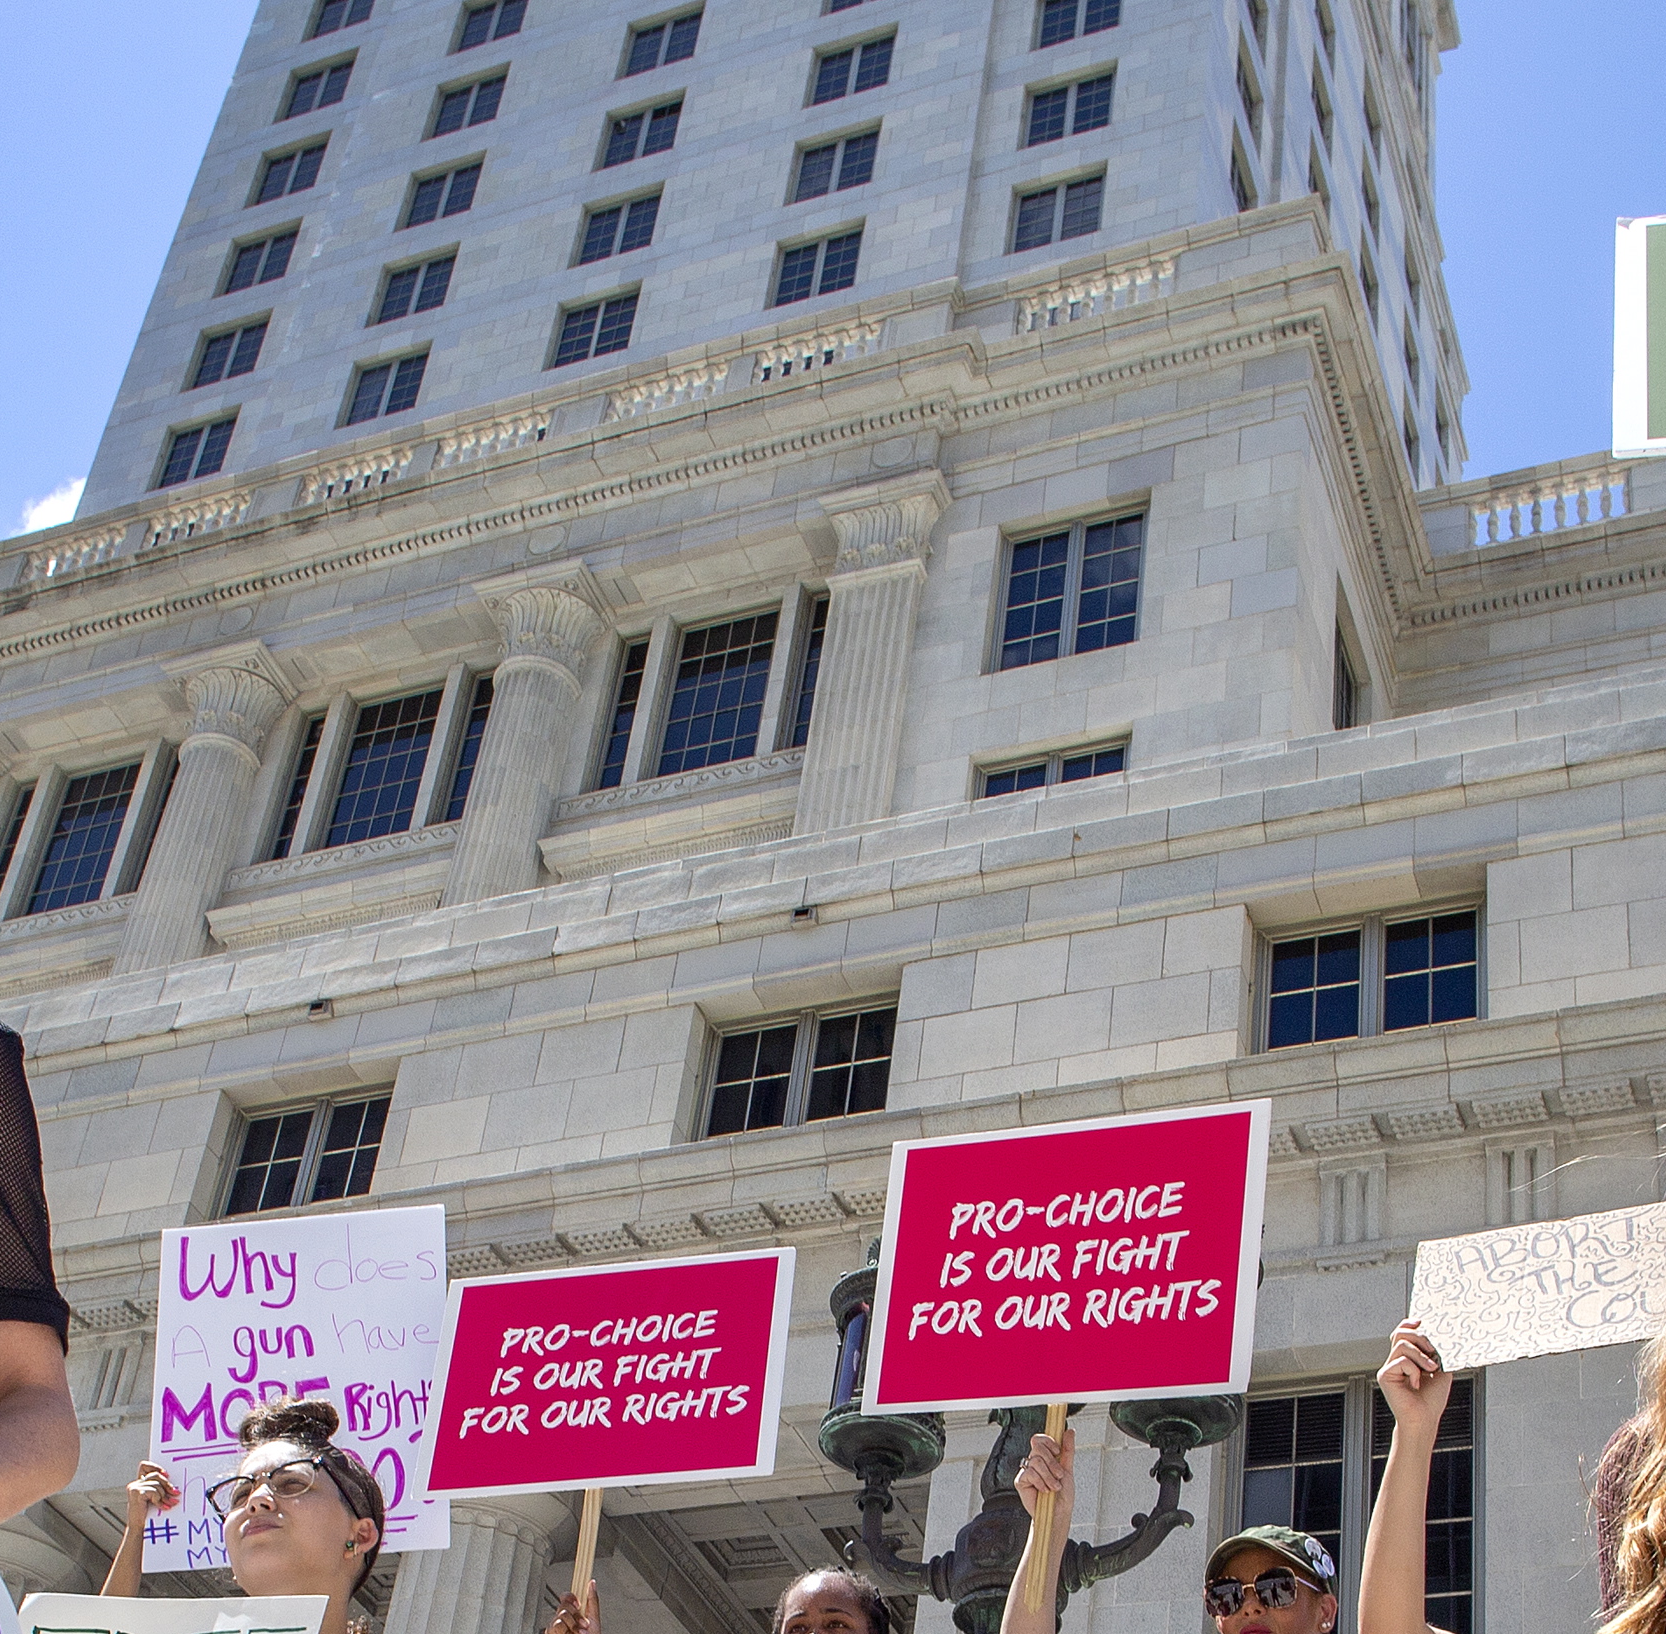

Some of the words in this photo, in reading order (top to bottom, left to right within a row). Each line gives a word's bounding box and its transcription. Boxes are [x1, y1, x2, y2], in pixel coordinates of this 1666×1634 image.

[949, 1181, 1186, 1240] PRO-CHOICE
[179, 1235, 298, 1310] Why
[313, 1223, 437, 1292] does
[939, 1250, 973, 1289] IS
[985, 1243, 1062, 1283] OUR
[1071, 1230, 1190, 1279] FIGHT
[1453, 1208, 1653, 1282] ABORT
[1509, 1259, 1637, 1296] THE
[500, 1310, 718, 1358] PRO-CHOICE
[908, 1299, 984, 1342] FOR
[994, 1291, 1071, 1332] OUR
[1082, 1279, 1222, 1330] RIGHTS
[171, 1324, 211, 1368] A
[227, 1322, 315, 1384] gun
[333, 1314, 440, 1356] have
[490, 1366, 524, 1397] IS
[533, 1359, 603, 1390] OUR
[613, 1347, 722, 1387] FIGHT
[459, 1404, 530, 1440] FOR
[541, 1397, 611, 1429] OUR
[622, 1385, 750, 1425] RIGHTS
